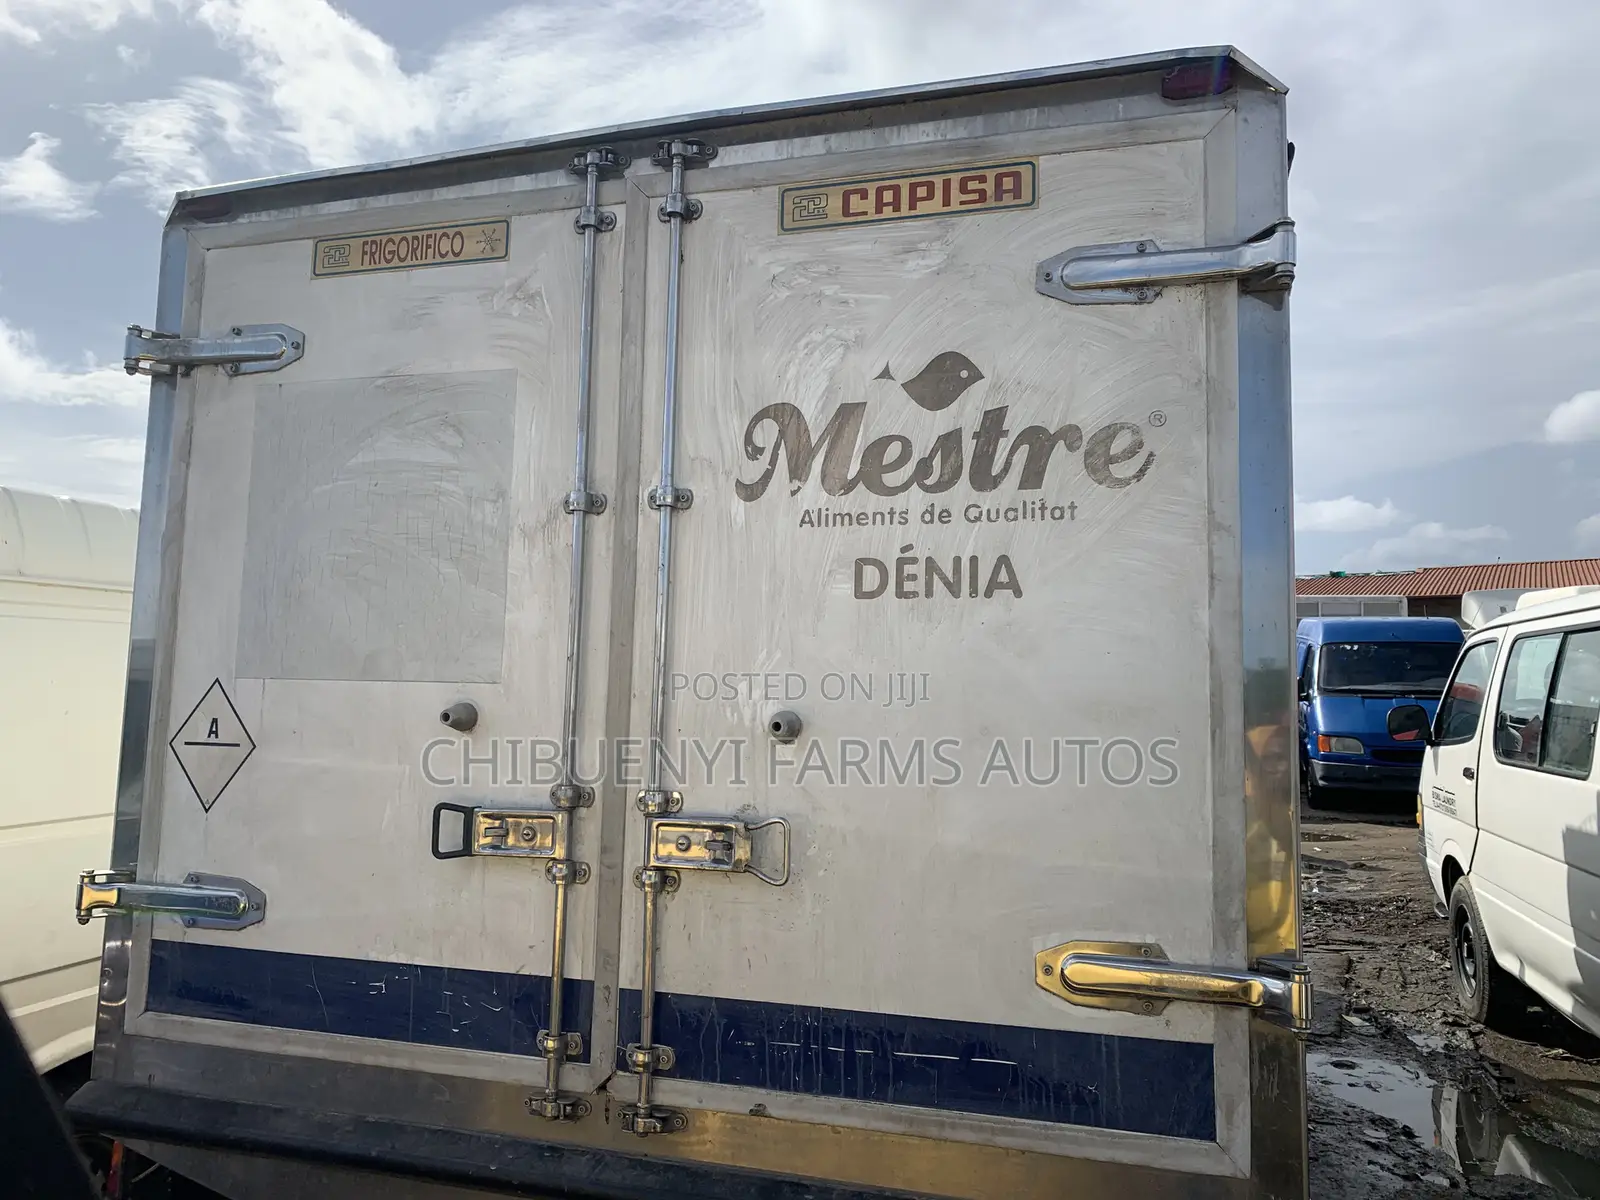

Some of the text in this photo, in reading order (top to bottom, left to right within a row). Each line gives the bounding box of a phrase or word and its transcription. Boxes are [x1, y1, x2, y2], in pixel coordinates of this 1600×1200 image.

[841, 170, 1023, 218] CAPISA
[360, 230, 465, 267] FRIGORIFICO
[735, 401, 1157, 503] Mestre
[799, 499, 1079, 529] Aliments de Qualitat
[853, 543, 1024, 600] DÉNIA
[207, 717, 219, 739] A
